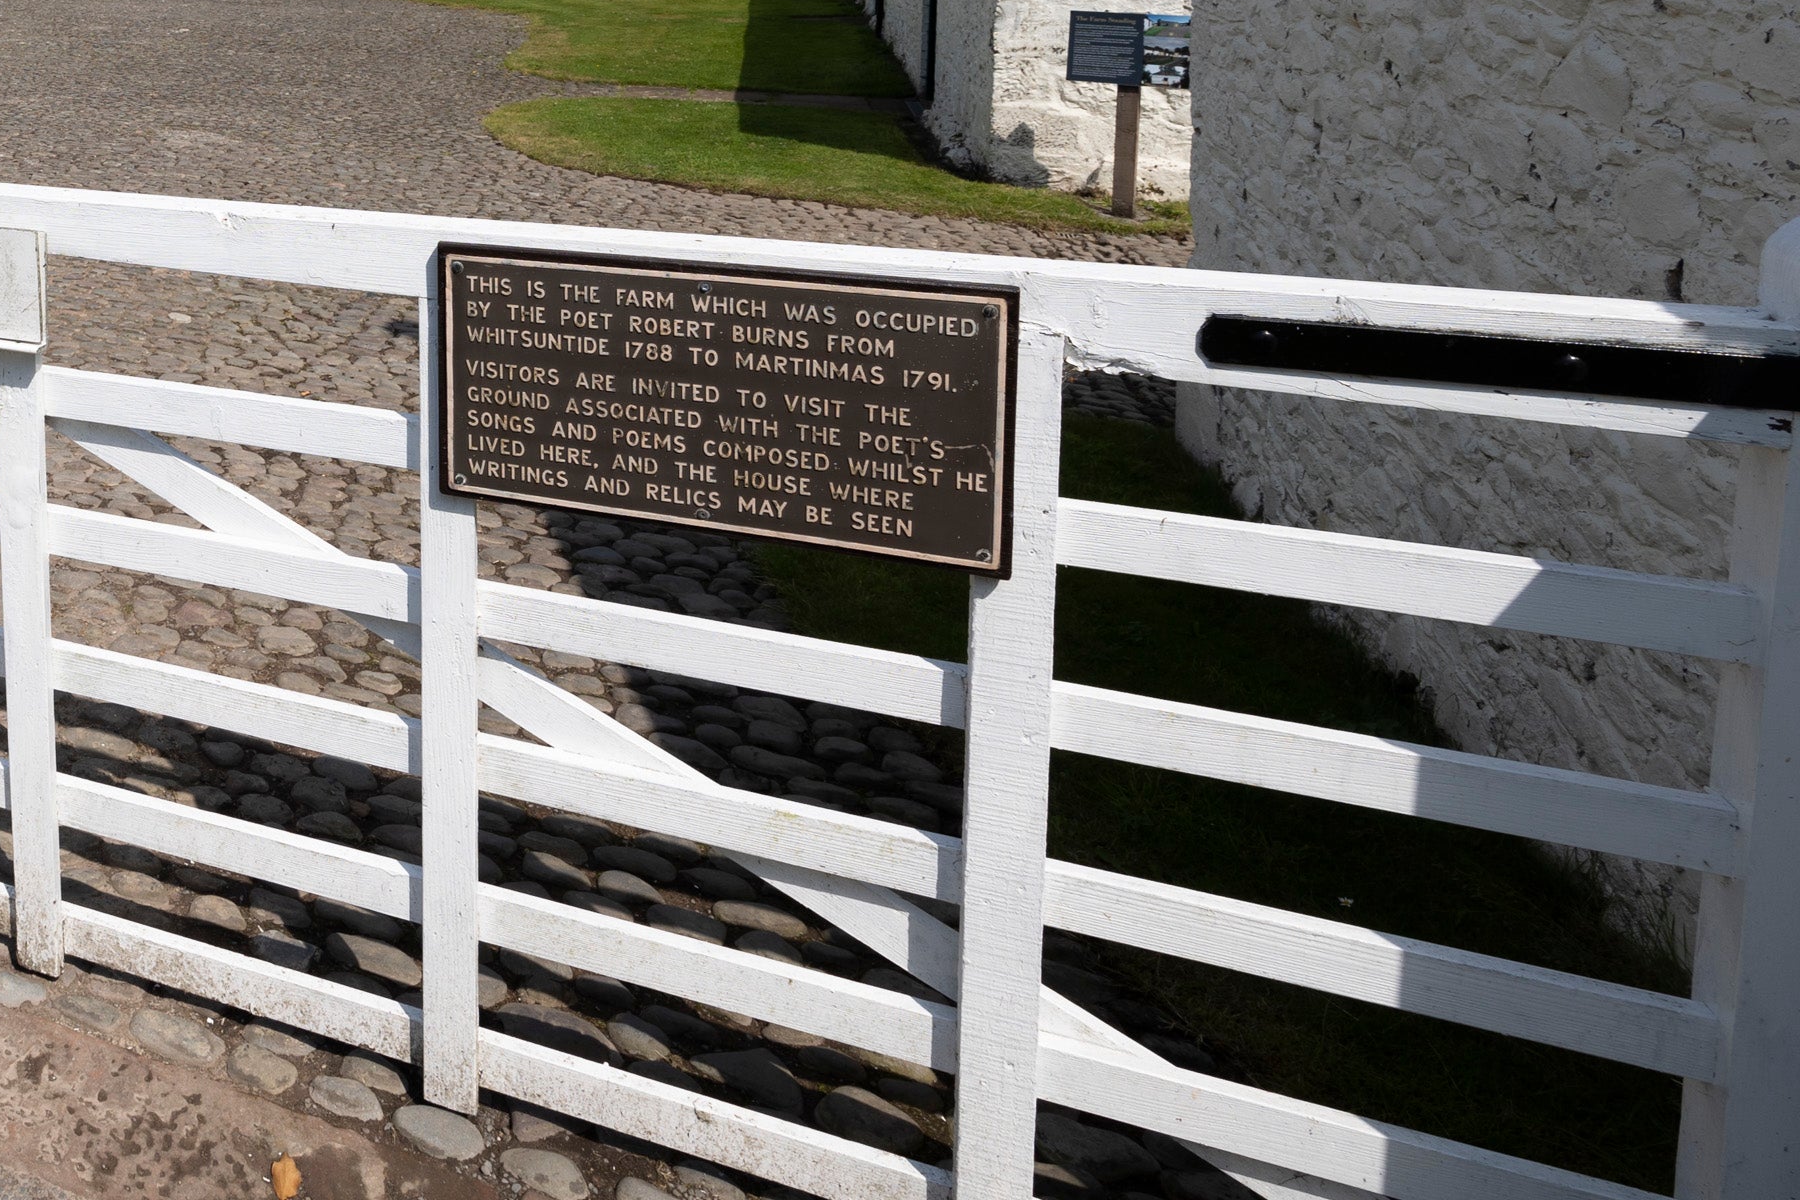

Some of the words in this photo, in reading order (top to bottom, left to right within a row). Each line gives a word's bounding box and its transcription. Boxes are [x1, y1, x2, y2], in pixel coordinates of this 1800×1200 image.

[466, 275, 512, 297] THIS
[527, 280, 546, 299] IS
[560, 283, 600, 304] THE
[616, 288, 674, 310] FARM
[691, 294, 767, 318] WHICH
[784, 302, 837, 325] WAS
[856, 310, 977, 338] OCCUPIED
[467, 301, 491, 318] BY
[507, 304, 546, 324] THE
[560, 309, 613, 330] POET
[630, 315, 715, 340] ROBERT
[732, 325, 809, 349] BURNS
[827, 334, 895, 358] FROM
[466, 359, 560, 386] VISITORS
[576, 372, 616, 392] ARE
[632, 378, 720, 403] INVITED
[737, 389, 767, 409] TO
[784, 394, 845, 418] VISIT
[865, 404, 911, 427] THE
[467, 326, 610, 356] WHITSUNTIDE
[625, 342, 673, 362] 1788
[689, 347, 719, 366] TO
[736, 351, 885, 385] MARTINMAS
[903, 370, 957, 393] 1791.
[467, 387, 550, 410] GROUND
[566, 398, 701, 429] ASSOCIATED
[719, 415, 778, 438] WITH
[797, 424, 841, 446] THE
[859, 431, 945, 460] POET'S
[467, 410, 535, 434] SONGS
[552, 421, 597, 441] AND
[612, 428, 686, 454] POEMS
[704, 440, 830, 471] COMPOSED
[848, 457, 943, 487] WHILST
[956, 471, 988, 492] HE
[468, 434, 525, 457] LIVED
[540, 444, 599, 469] HERE,
[613, 455, 658, 475] AND
[675, 462, 717, 483] THE
[734, 470, 811, 496] HOUSE
[829, 482, 914, 511] WHERE
[468, 458, 568, 488] WRITINGS
[585, 476, 630, 496] AND
[646, 484, 721, 509] RELICS
[738, 497, 788, 519] MAY
[806, 505, 833, 526] BE
[851, 512, 913, 537] SEEN
